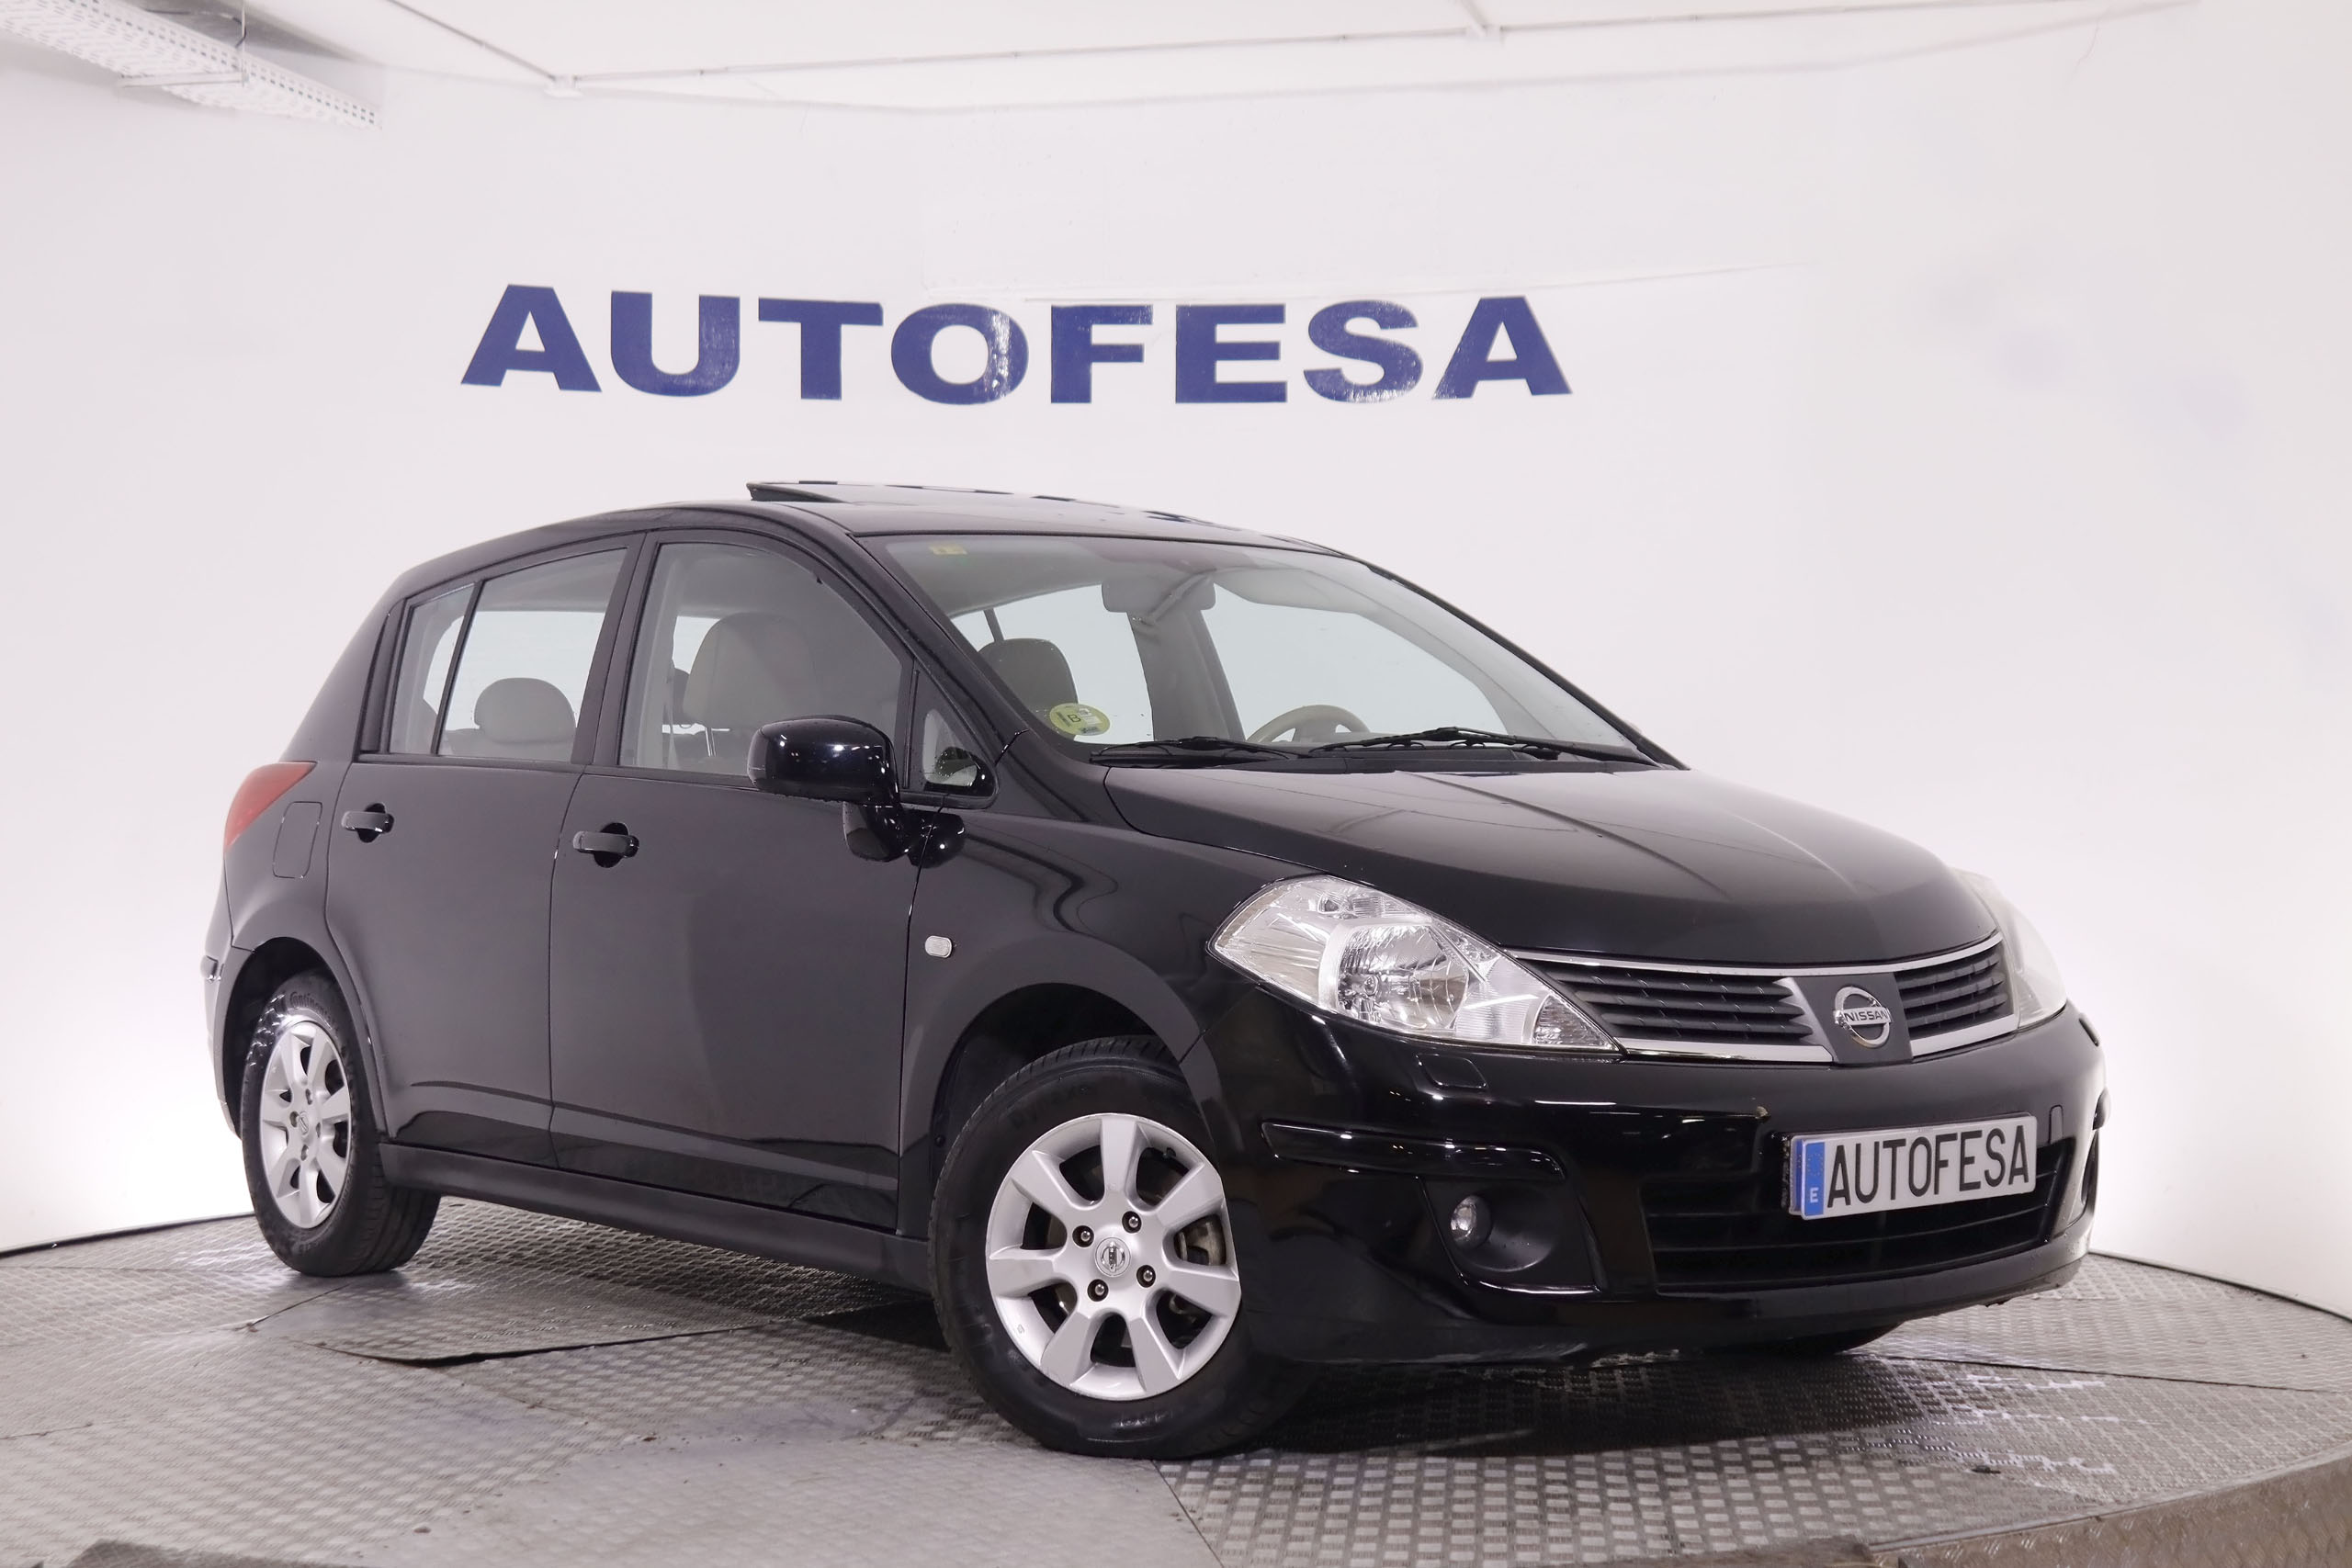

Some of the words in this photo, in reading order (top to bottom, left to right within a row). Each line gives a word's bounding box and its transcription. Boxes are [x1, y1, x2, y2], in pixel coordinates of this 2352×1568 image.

[461, 285, 1570, 405] AUTOFESA
[1843, 1010, 1888, 1022] NISSAN
[1827, 1125, 2029, 1208] AUTOFESA
[1810, 1188, 1818, 1202] E
